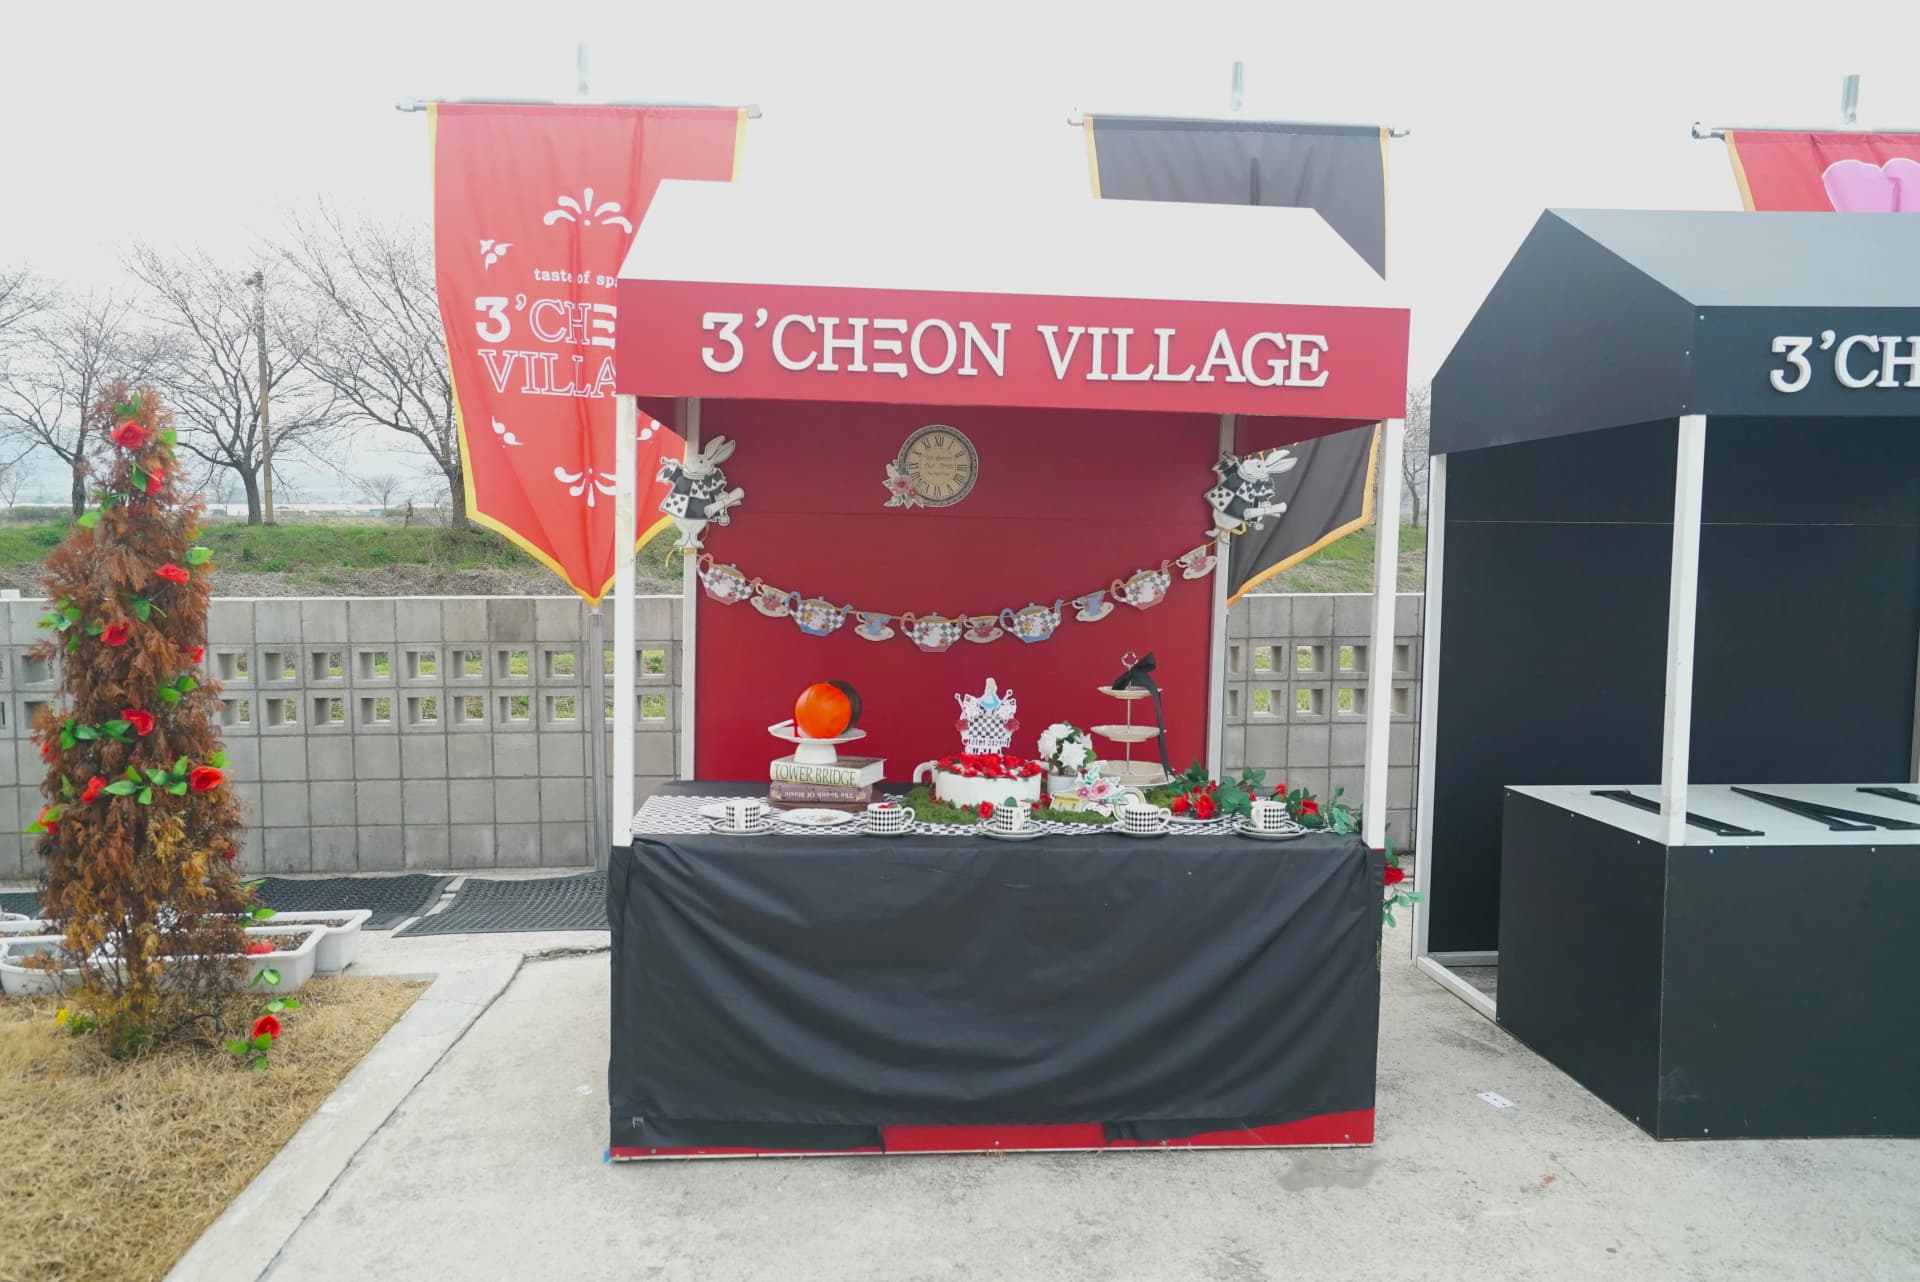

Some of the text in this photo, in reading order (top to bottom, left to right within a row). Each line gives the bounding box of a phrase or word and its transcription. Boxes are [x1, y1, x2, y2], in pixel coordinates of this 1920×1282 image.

[534, 268, 617, 288] taste of sp
[702, 308, 1329, 387] 3'CHEON VILLAGE
[478, 349, 616, 398] VILLA
[774, 763, 857, 786] TOWER BRIDGE
